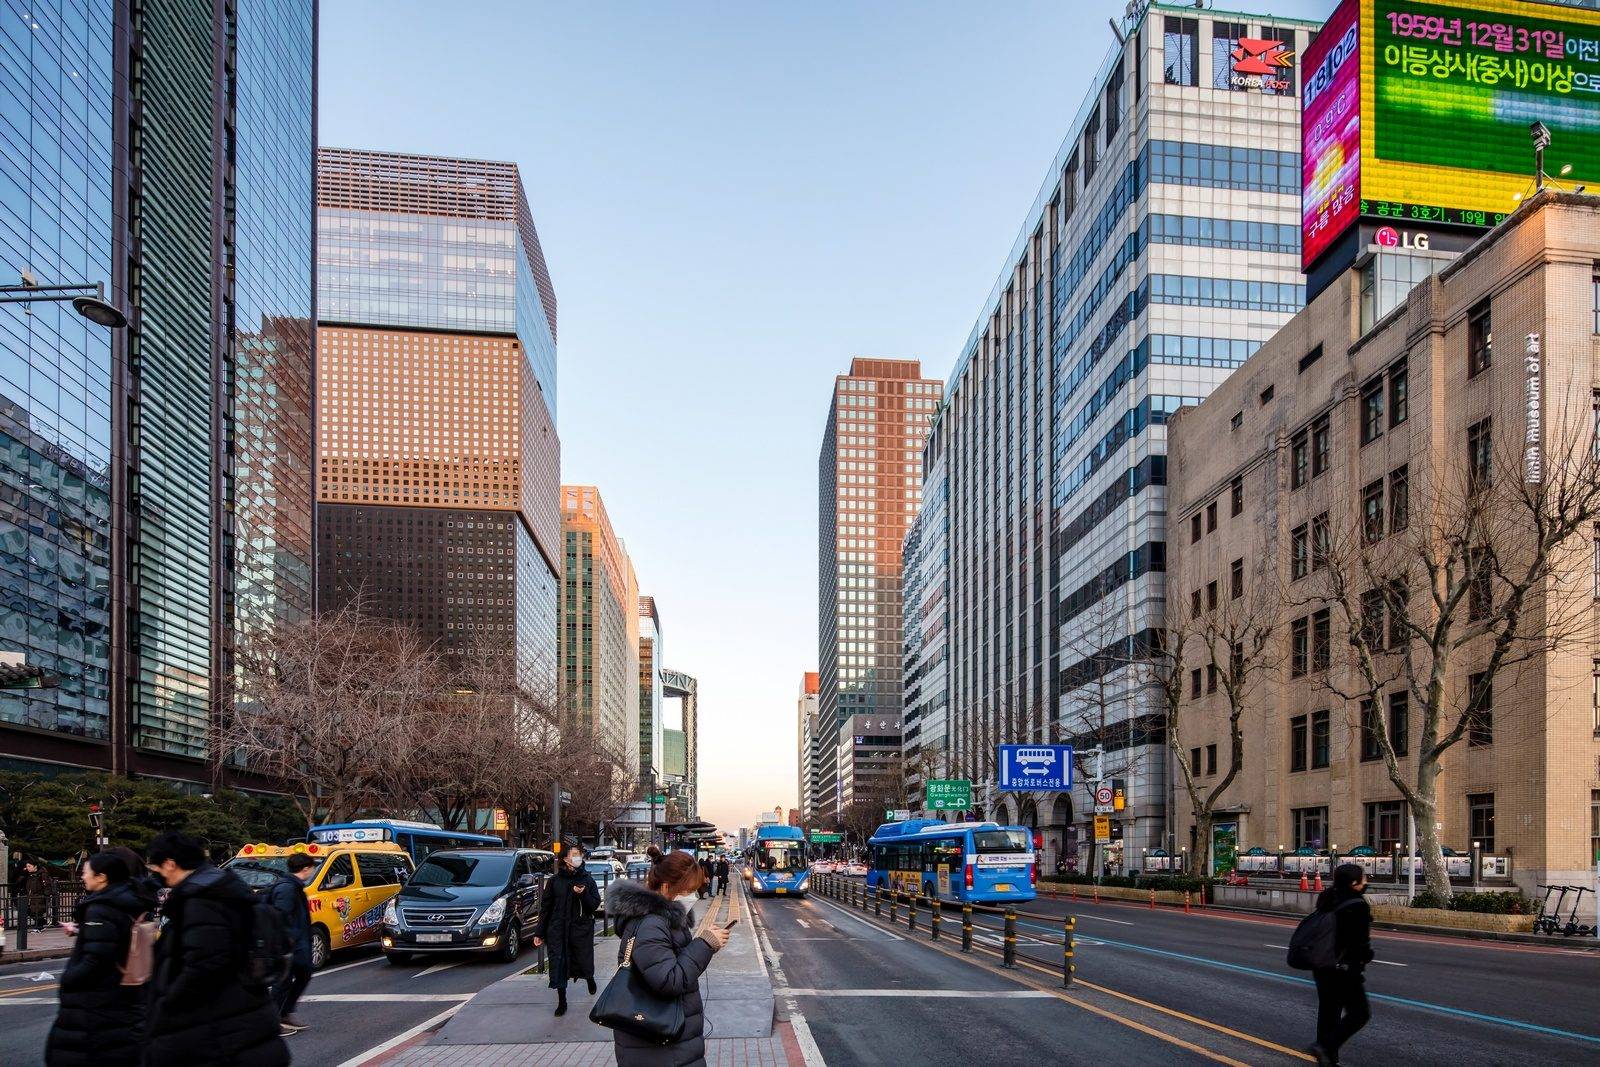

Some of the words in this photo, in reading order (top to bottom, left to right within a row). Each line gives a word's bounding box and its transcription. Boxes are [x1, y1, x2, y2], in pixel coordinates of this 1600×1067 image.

[1386, 12, 1462, 46] 1959년
[1466, 22, 1514, 52] 12월
[1515, 28, 1564, 59] 31일
[1231, 76, 1263, 88] KOREA
[1265, 80, 1290, 90] POST
[1308, 210, 1329, 239] 구름
[1333, 184, 1355, 217] 많음
[1376, 201, 1404, 217] 공군
[1460, 210, 1486, 226] 19일
[1403, 231, 1429, 250] LG
[1525, 332, 1540, 354] art
[1524, 355, 1540, 373] of
[1526, 377, 1540, 442] museum
[929, 784, 951, 793] 광화문
[1011, 777, 1060, 788] 중앙차로버스전용
[1100, 792, 1110, 800] 50
[321, 831, 340, 842] 103
